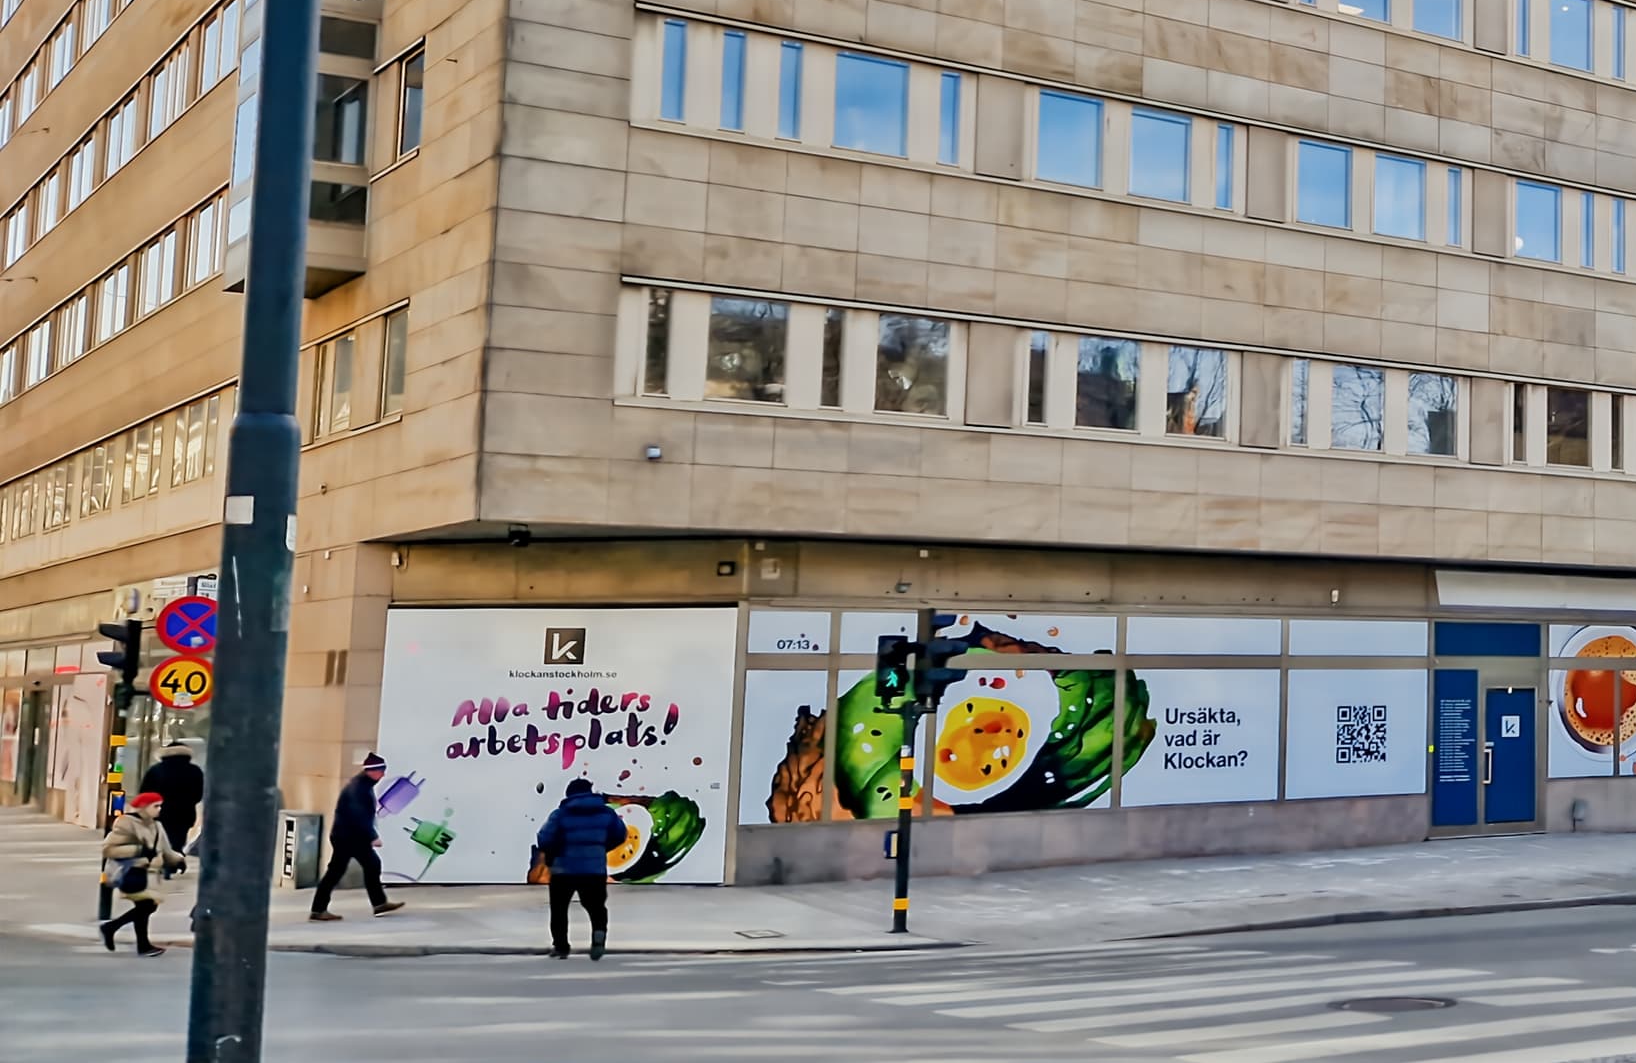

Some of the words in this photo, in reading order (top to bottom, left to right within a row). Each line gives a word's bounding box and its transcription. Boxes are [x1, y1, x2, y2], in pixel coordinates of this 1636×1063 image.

[776, 639, 811, 651] 07:13
[160, 669, 208, 696] 40
[508, 669, 618, 680] klockanstockholm.se
[451, 696, 530, 727] Alla
[541, 687, 651, 720] tiders
[1165, 707, 1241, 726] Ursäkta,
[446, 702, 679, 770] arbetsplats!
[1164, 729, 1197, 747] vad
[1202, 729, 1221, 746] är
[1164, 750, 1248, 770] Klockan?
